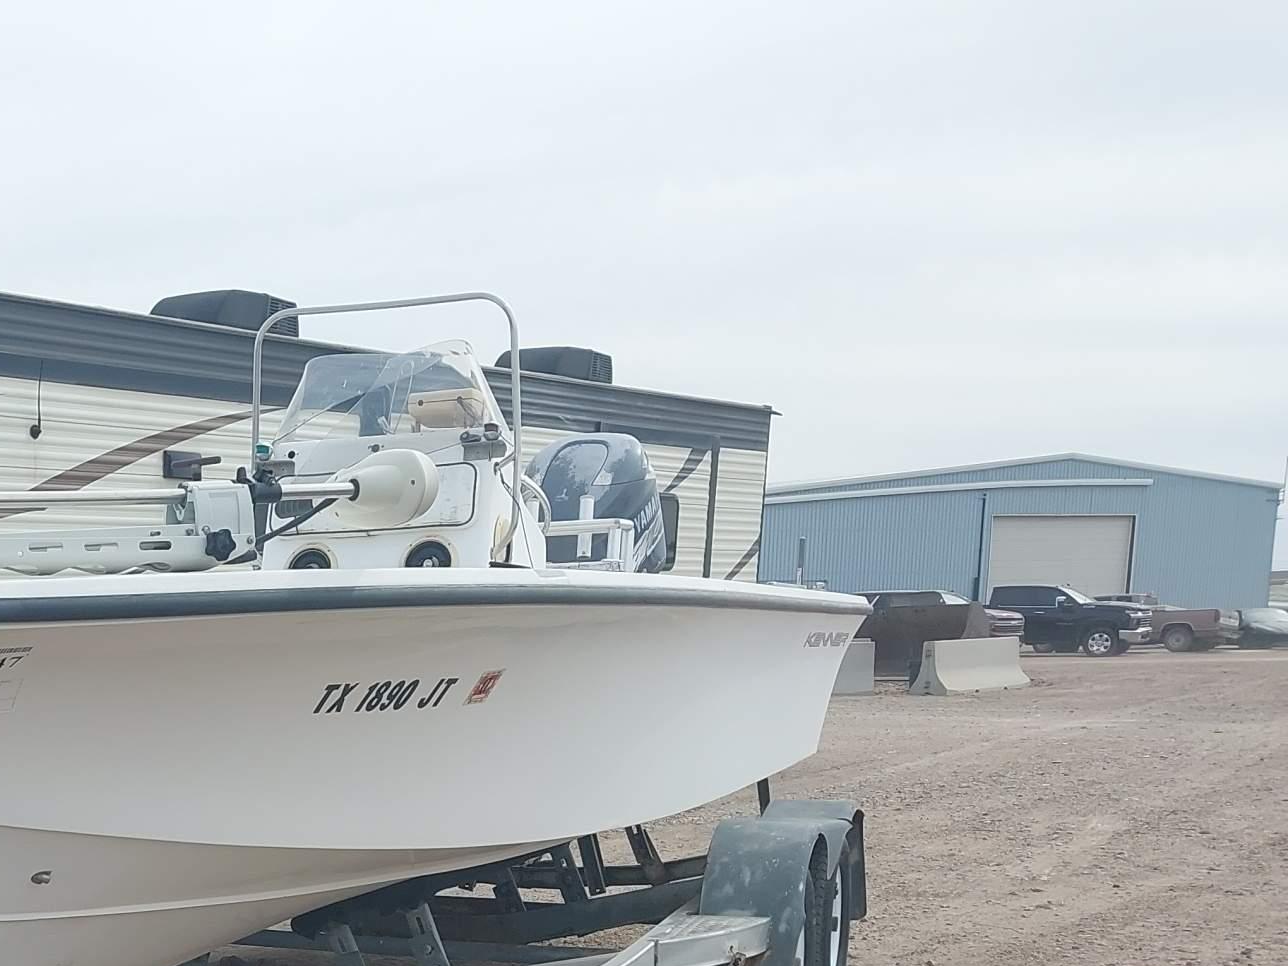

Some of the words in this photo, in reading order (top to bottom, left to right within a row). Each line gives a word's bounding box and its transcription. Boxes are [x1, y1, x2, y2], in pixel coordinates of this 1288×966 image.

[312, 682, 360, 714] TX
[354, 678, 420, 713] 1890
[416, 677, 460, 709] JT
